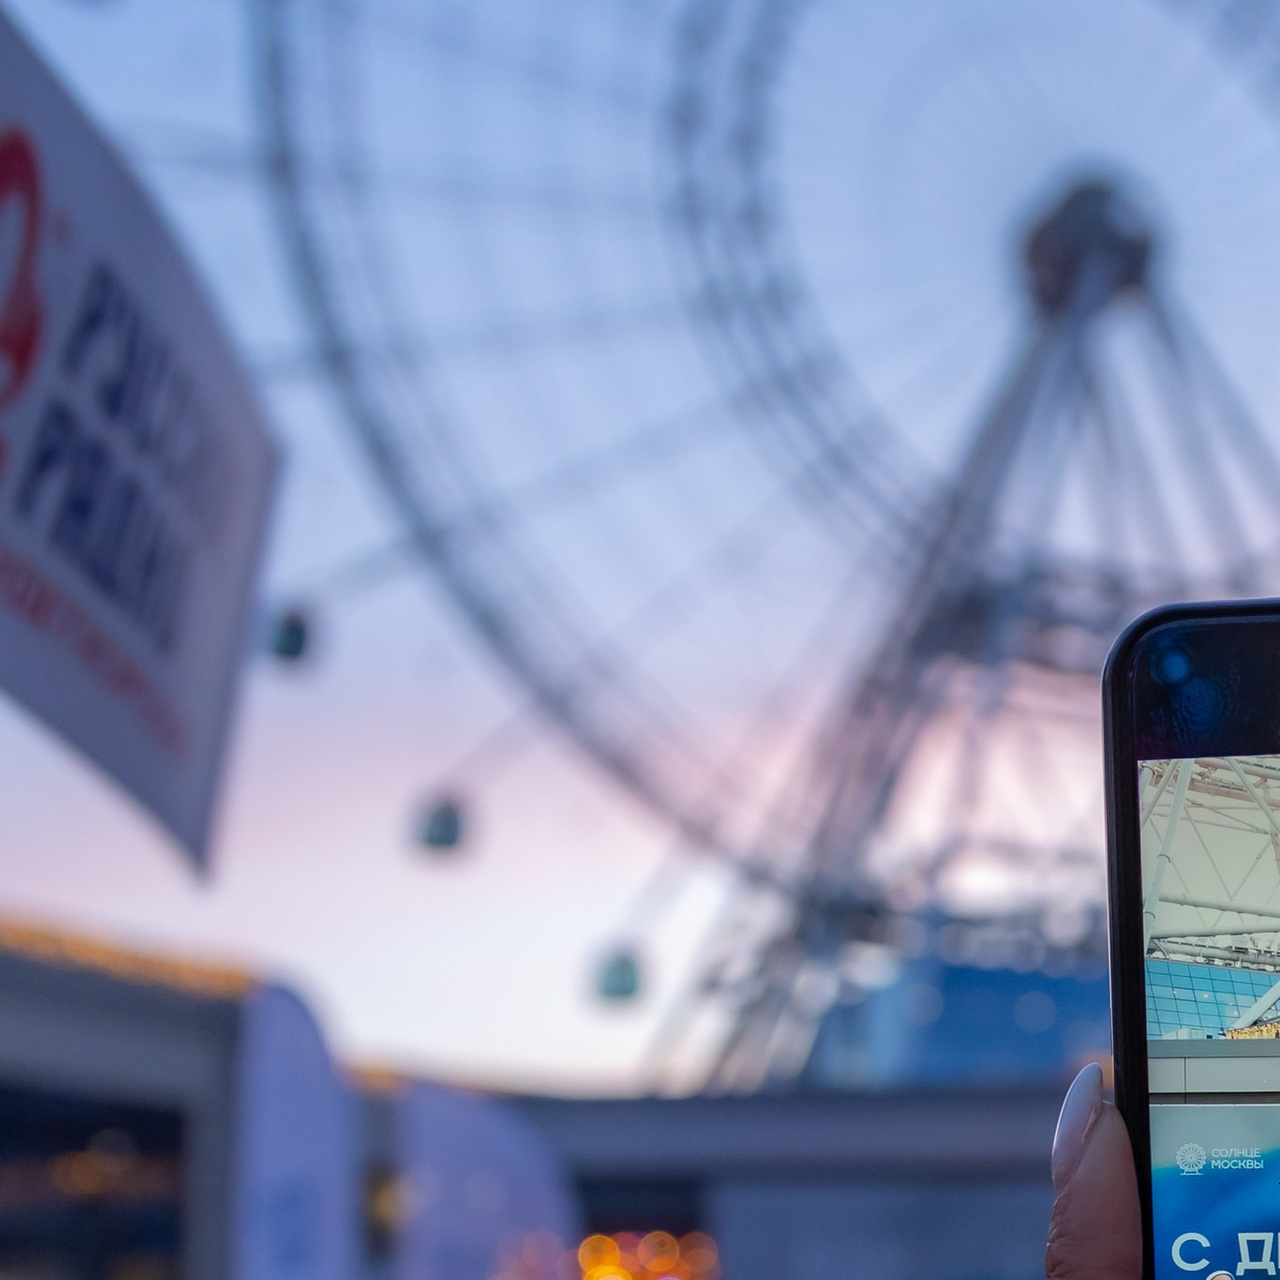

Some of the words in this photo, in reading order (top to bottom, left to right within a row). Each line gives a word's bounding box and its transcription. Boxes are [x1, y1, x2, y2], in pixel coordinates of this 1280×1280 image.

[1211, 1148, 1261, 1159] СОЛНЦЕ
[1211, 1159, 1264, 1170] МОСКВЫ
[1171, 1232, 1211, 1272] С
